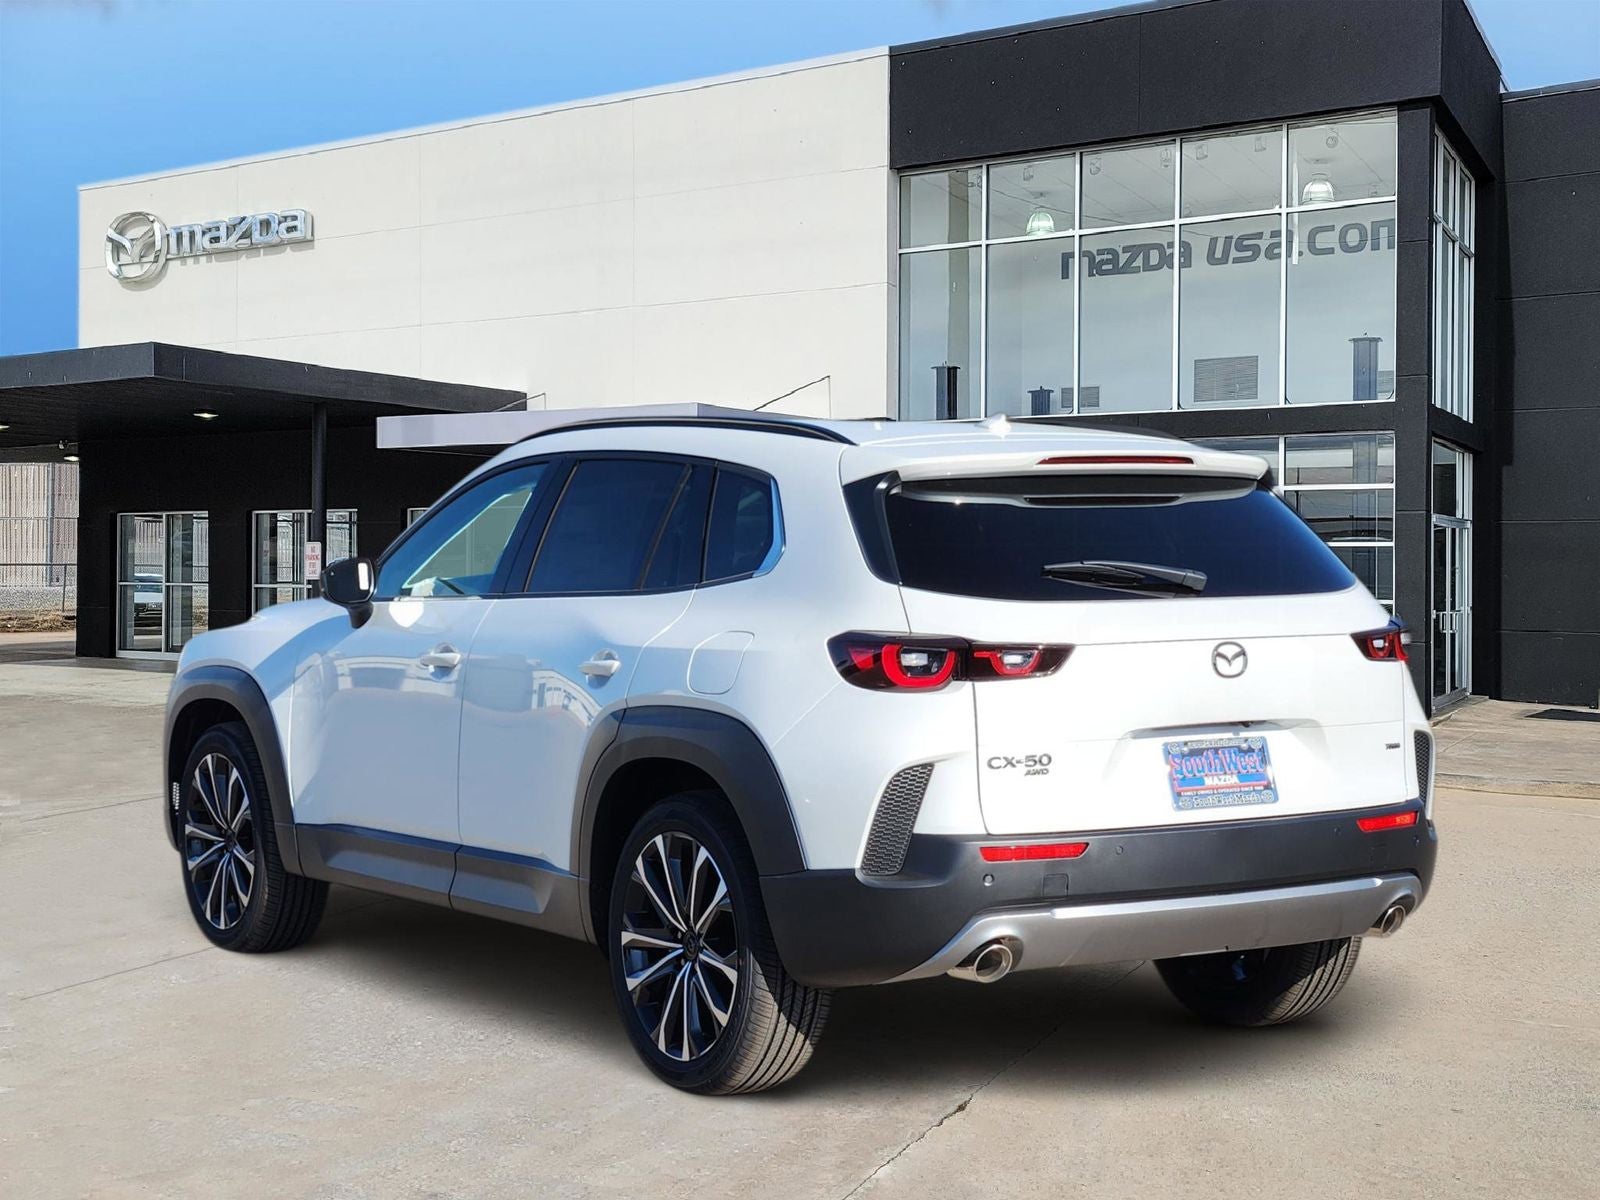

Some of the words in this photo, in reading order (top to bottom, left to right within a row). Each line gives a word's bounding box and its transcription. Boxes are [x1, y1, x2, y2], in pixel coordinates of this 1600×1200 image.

[986, 753, 1052, 770] CX-50
[1169, 747, 1268, 779] SouthWest
[1024, 768, 1050, 776] AWD
[1203, 774, 1240, 786] MAZDA
